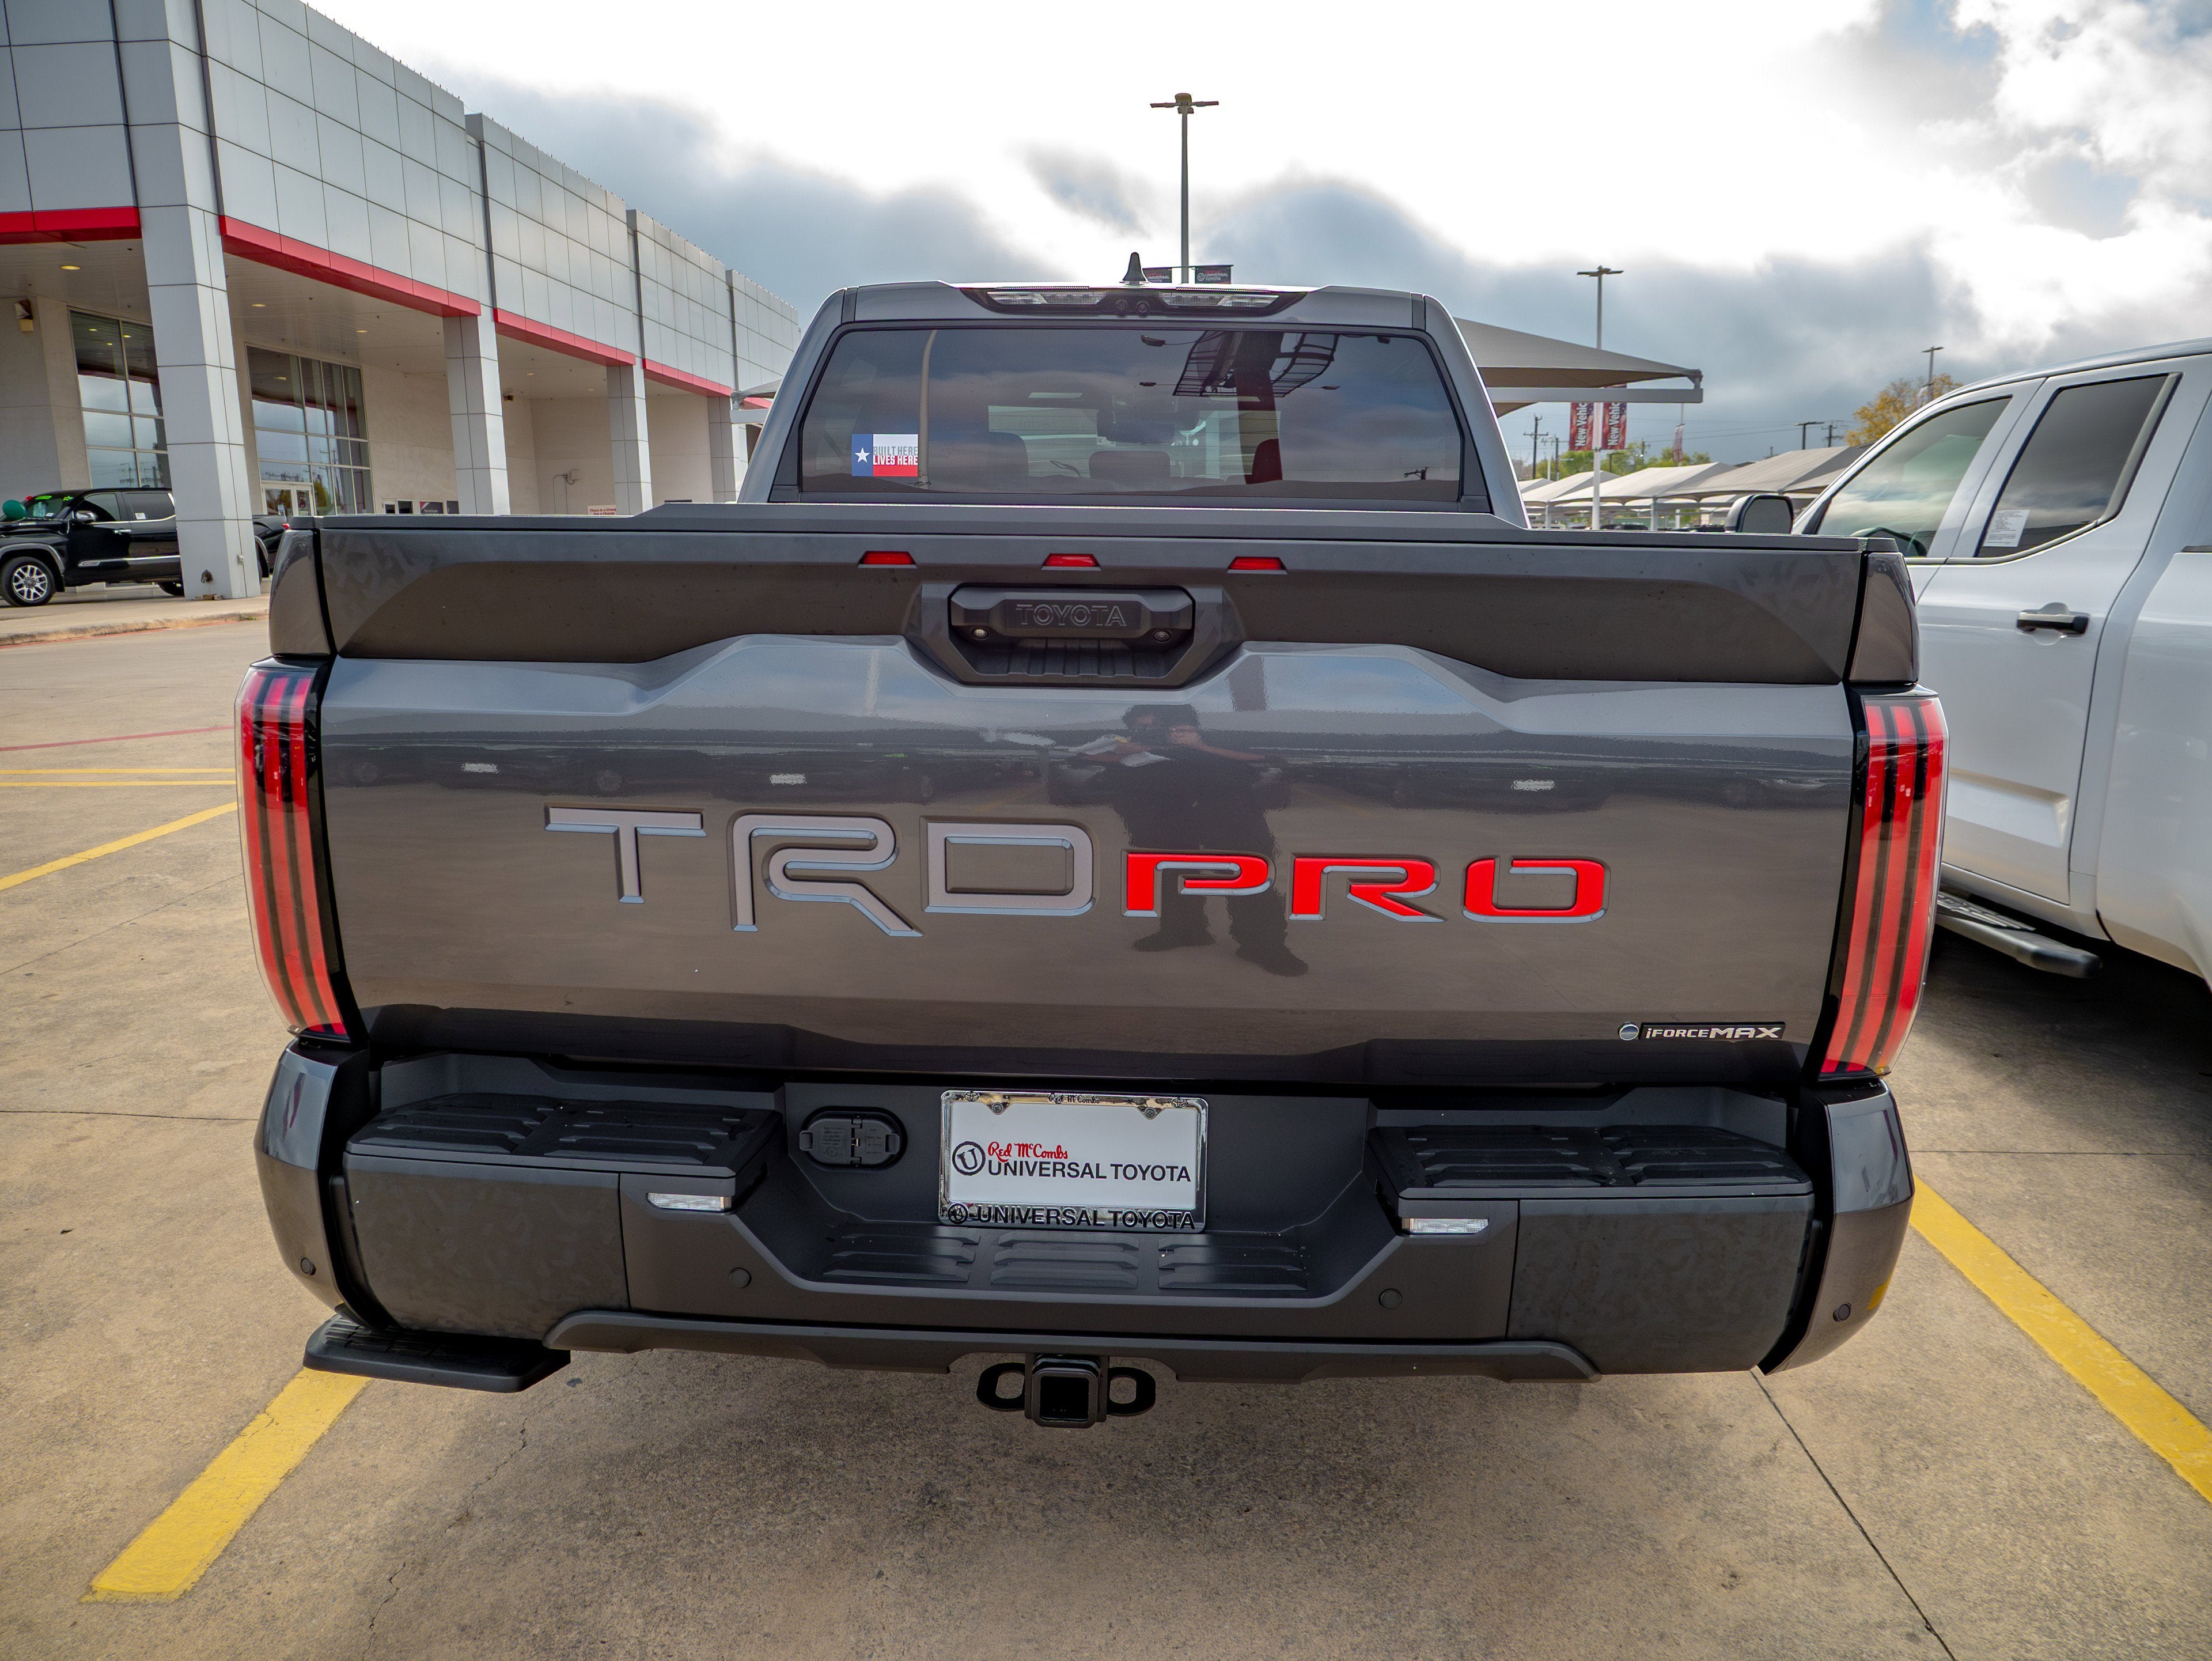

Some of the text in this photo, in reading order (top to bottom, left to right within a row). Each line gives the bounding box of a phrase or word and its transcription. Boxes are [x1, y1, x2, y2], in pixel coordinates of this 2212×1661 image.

[1575, 427, 1586, 447] New
[1608, 427, 1620, 446] New
[873, 446, 918, 456] BUILT HERE
[873, 455, 918, 466] LIVES HERE
[1016, 603, 1127, 627] TOYOTA
[546, 805, 1608, 938] TRD PRO
[1048, 1092, 1100, 1104] Red McCombs
[988, 1141, 1069, 1163] Red McCombs
[988, 1160, 1191, 1182] UNIVERSAL TOYOTA
[978, 1204, 1196, 1229] UNIVERSAL TOYOTA
